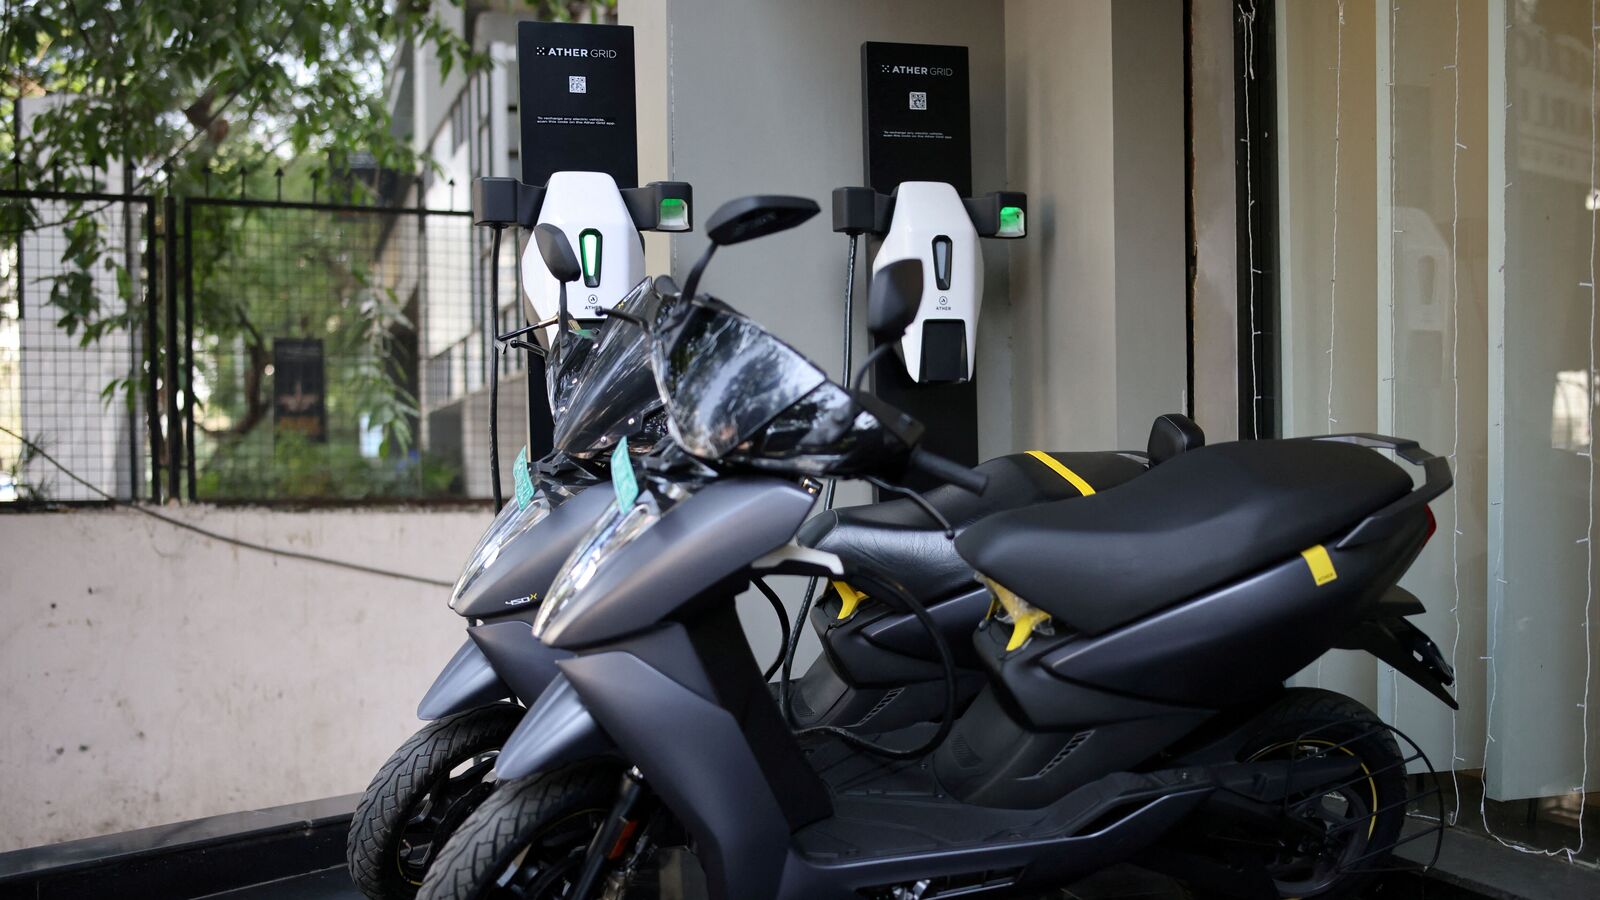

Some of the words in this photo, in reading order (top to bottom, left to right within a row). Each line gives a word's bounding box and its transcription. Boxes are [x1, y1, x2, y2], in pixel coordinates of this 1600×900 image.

[548, 47, 588, 57] ATHER
[590, 49, 617, 59] GRID
[892, 65, 928, 75] ATHER
[929, 67, 953, 76] GRID
